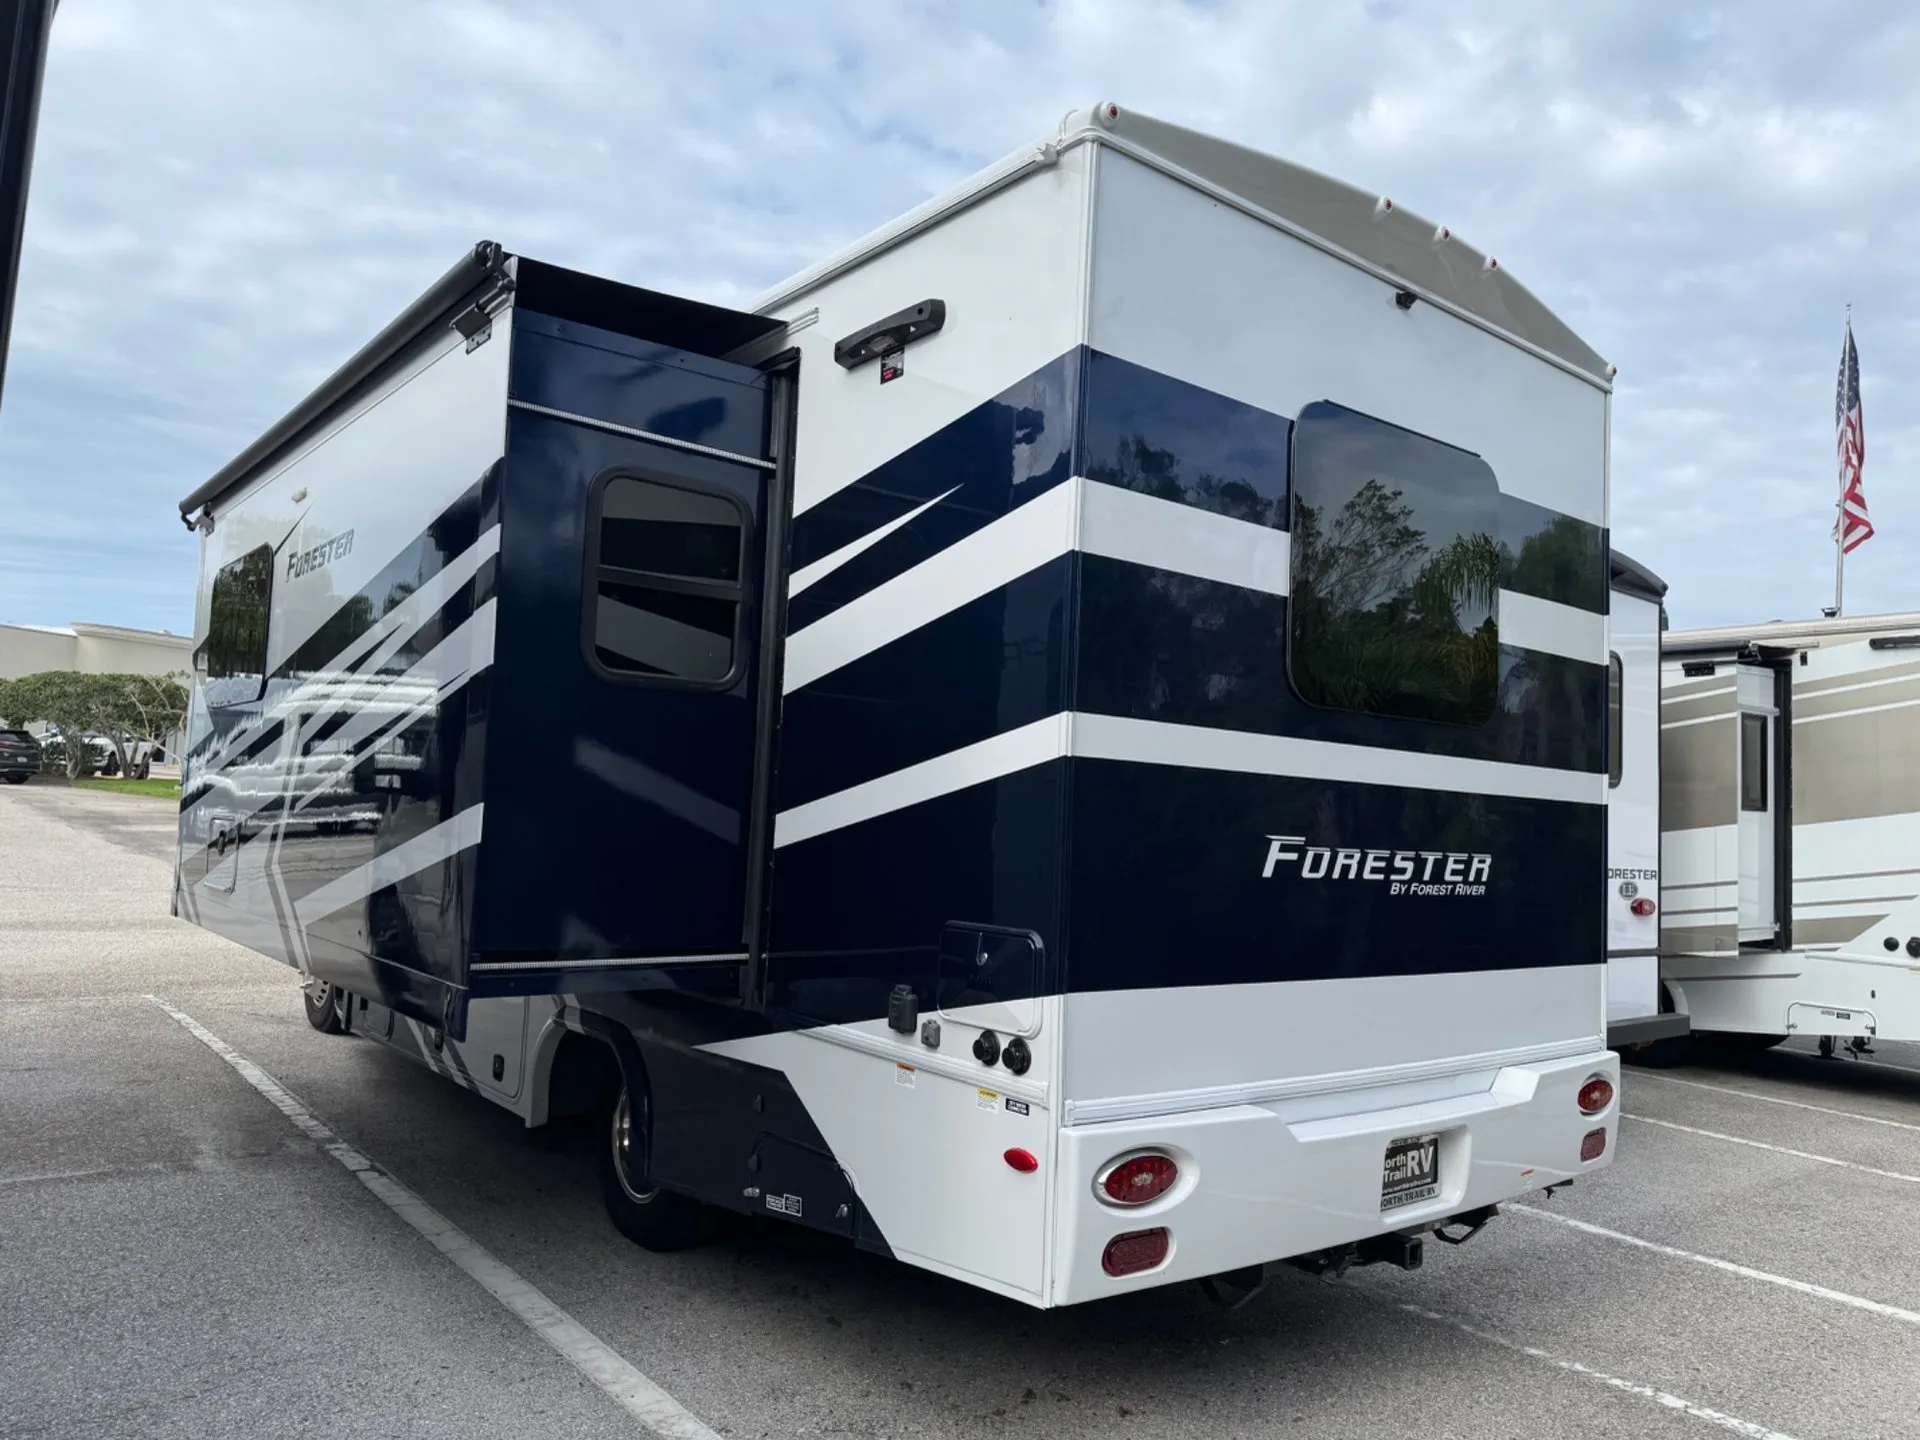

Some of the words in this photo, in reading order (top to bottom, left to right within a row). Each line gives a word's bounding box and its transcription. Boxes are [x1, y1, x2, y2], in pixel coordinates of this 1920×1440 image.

[285, 528, 355, 584] FORESTER
[1262, 834, 1492, 882] FORESTER
[1608, 867, 1657, 880] ORESTER
[1390, 882, 1408, 895] BY
[1410, 882, 1453, 896] FOREST
[1455, 883, 1486, 896] RIVER
[1385, 1153, 1406, 1169] orth
[1407, 1145, 1434, 1177] RV
[1383, 1166, 1406, 1183] Trail
